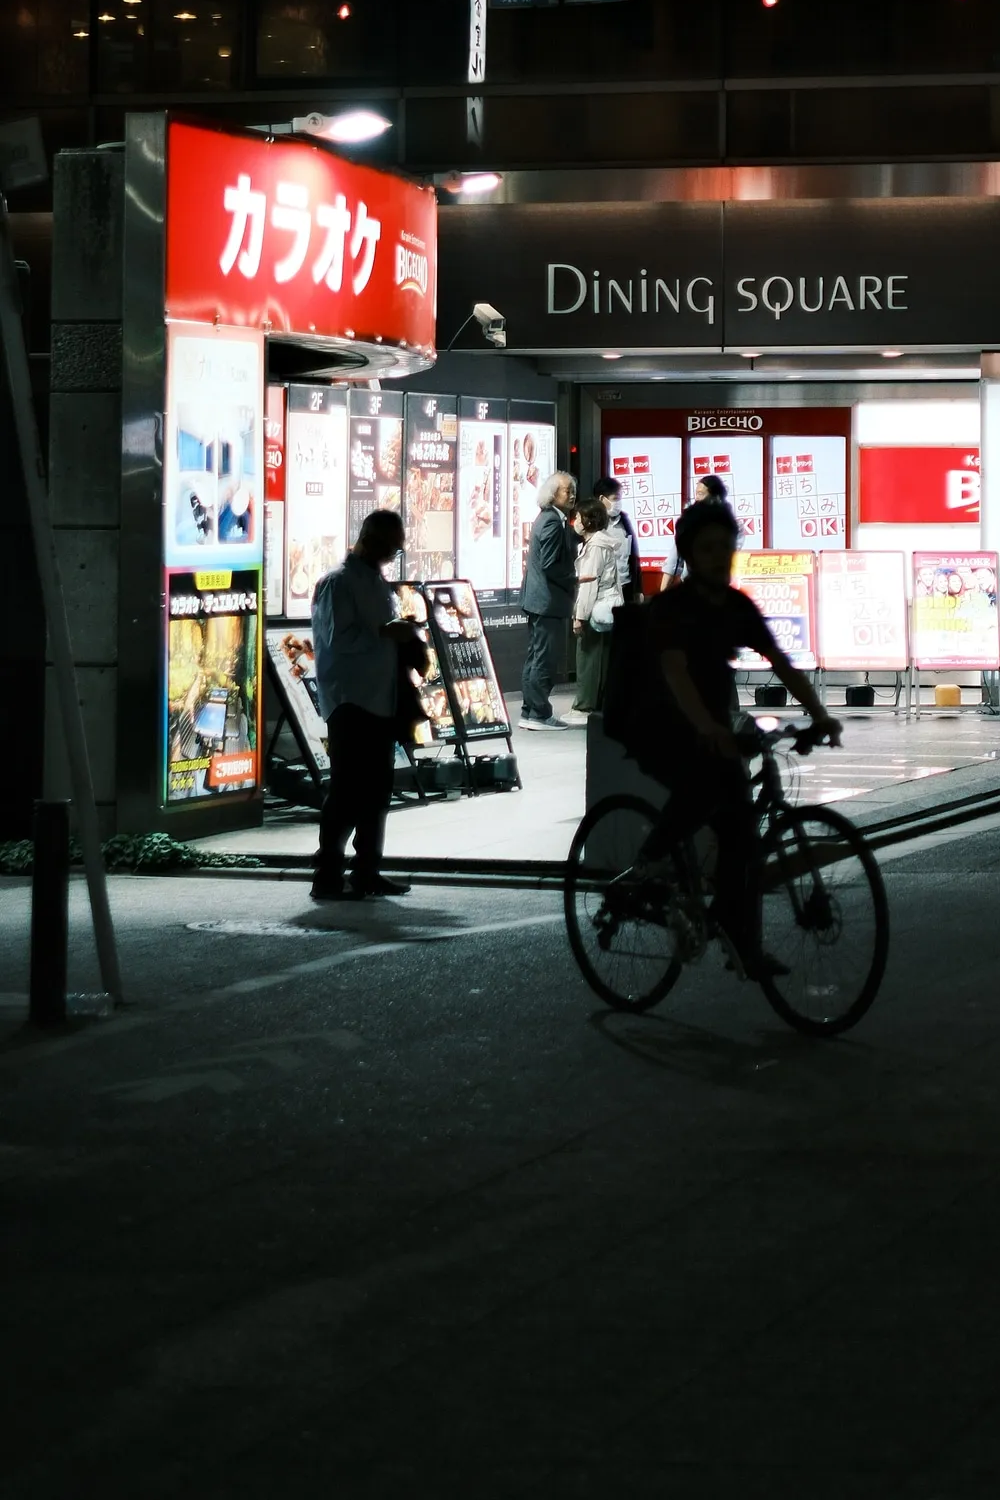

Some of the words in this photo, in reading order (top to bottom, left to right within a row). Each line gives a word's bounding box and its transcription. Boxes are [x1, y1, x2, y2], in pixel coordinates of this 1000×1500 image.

[220, 172, 381, 296] カラオケ
[737, 275, 909, 320] SQUARE
[311, 392, 324, 411] 2F
[370, 396, 382, 415] 3F
[425, 399, 437, 418] 4F
[477, 402, 489, 420] 5F
[776, 475, 813, 496] 持ち
[636, 498, 673, 517] 込み
[800, 496, 836, 516] 込み
[940, 556, 991, 567] KARAOKE
